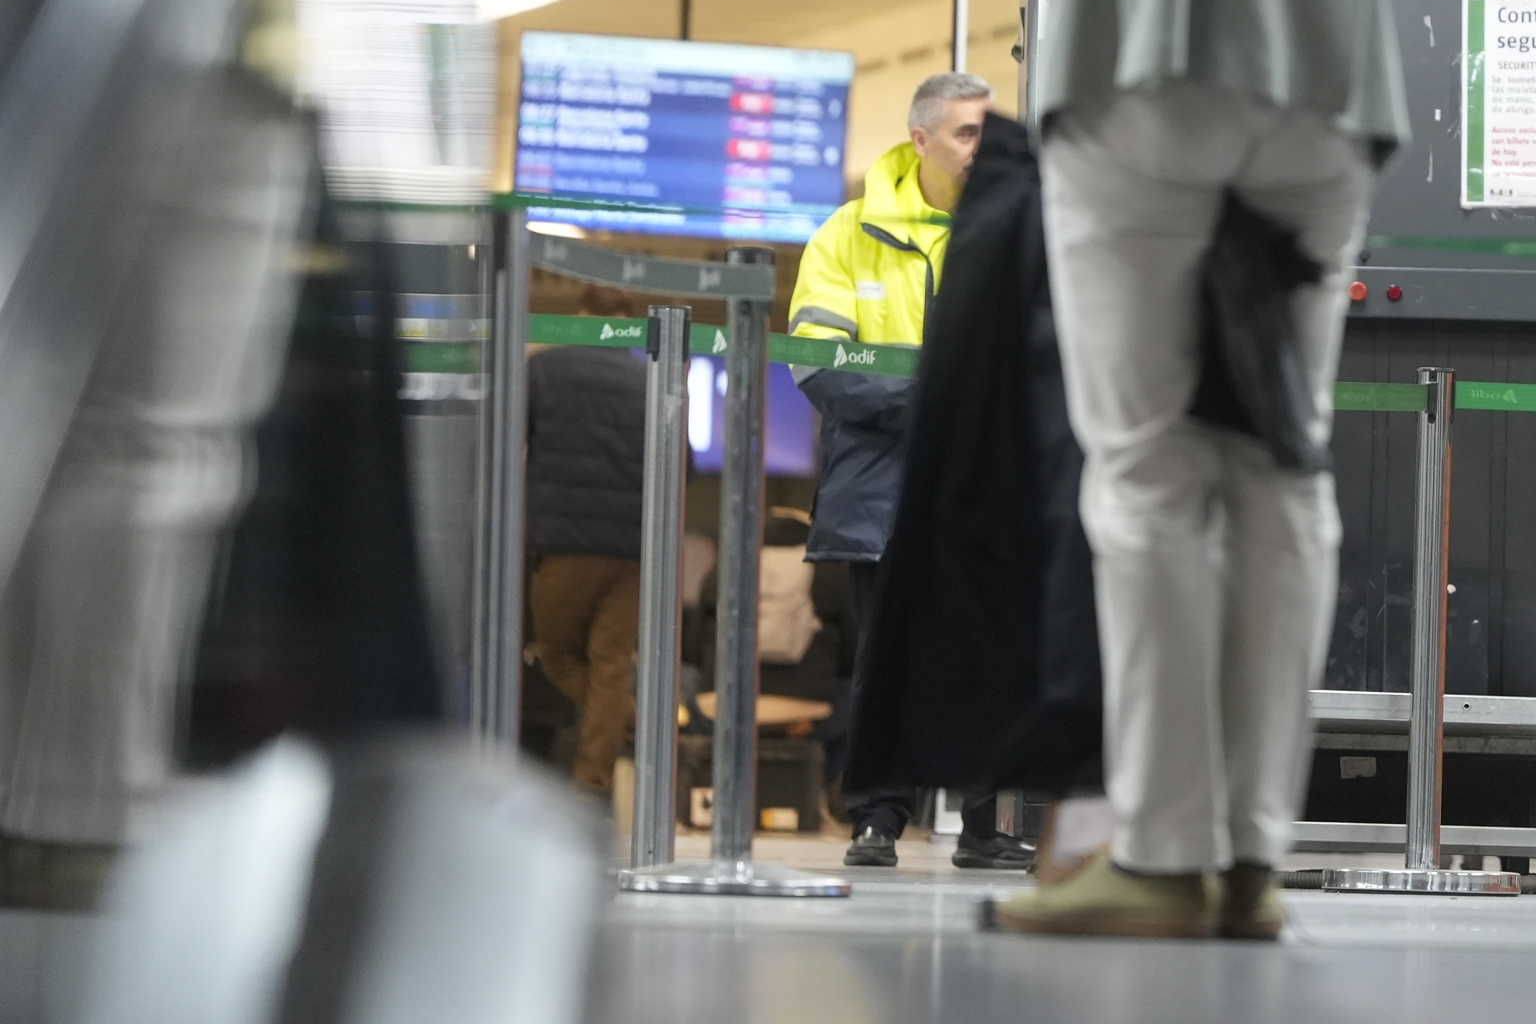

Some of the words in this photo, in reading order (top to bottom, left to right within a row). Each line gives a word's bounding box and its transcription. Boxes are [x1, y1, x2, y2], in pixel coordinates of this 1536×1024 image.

[1491, 76, 1502, 84] Se
[614, 326, 642, 338] adif
[848, 350, 876, 366] adif
